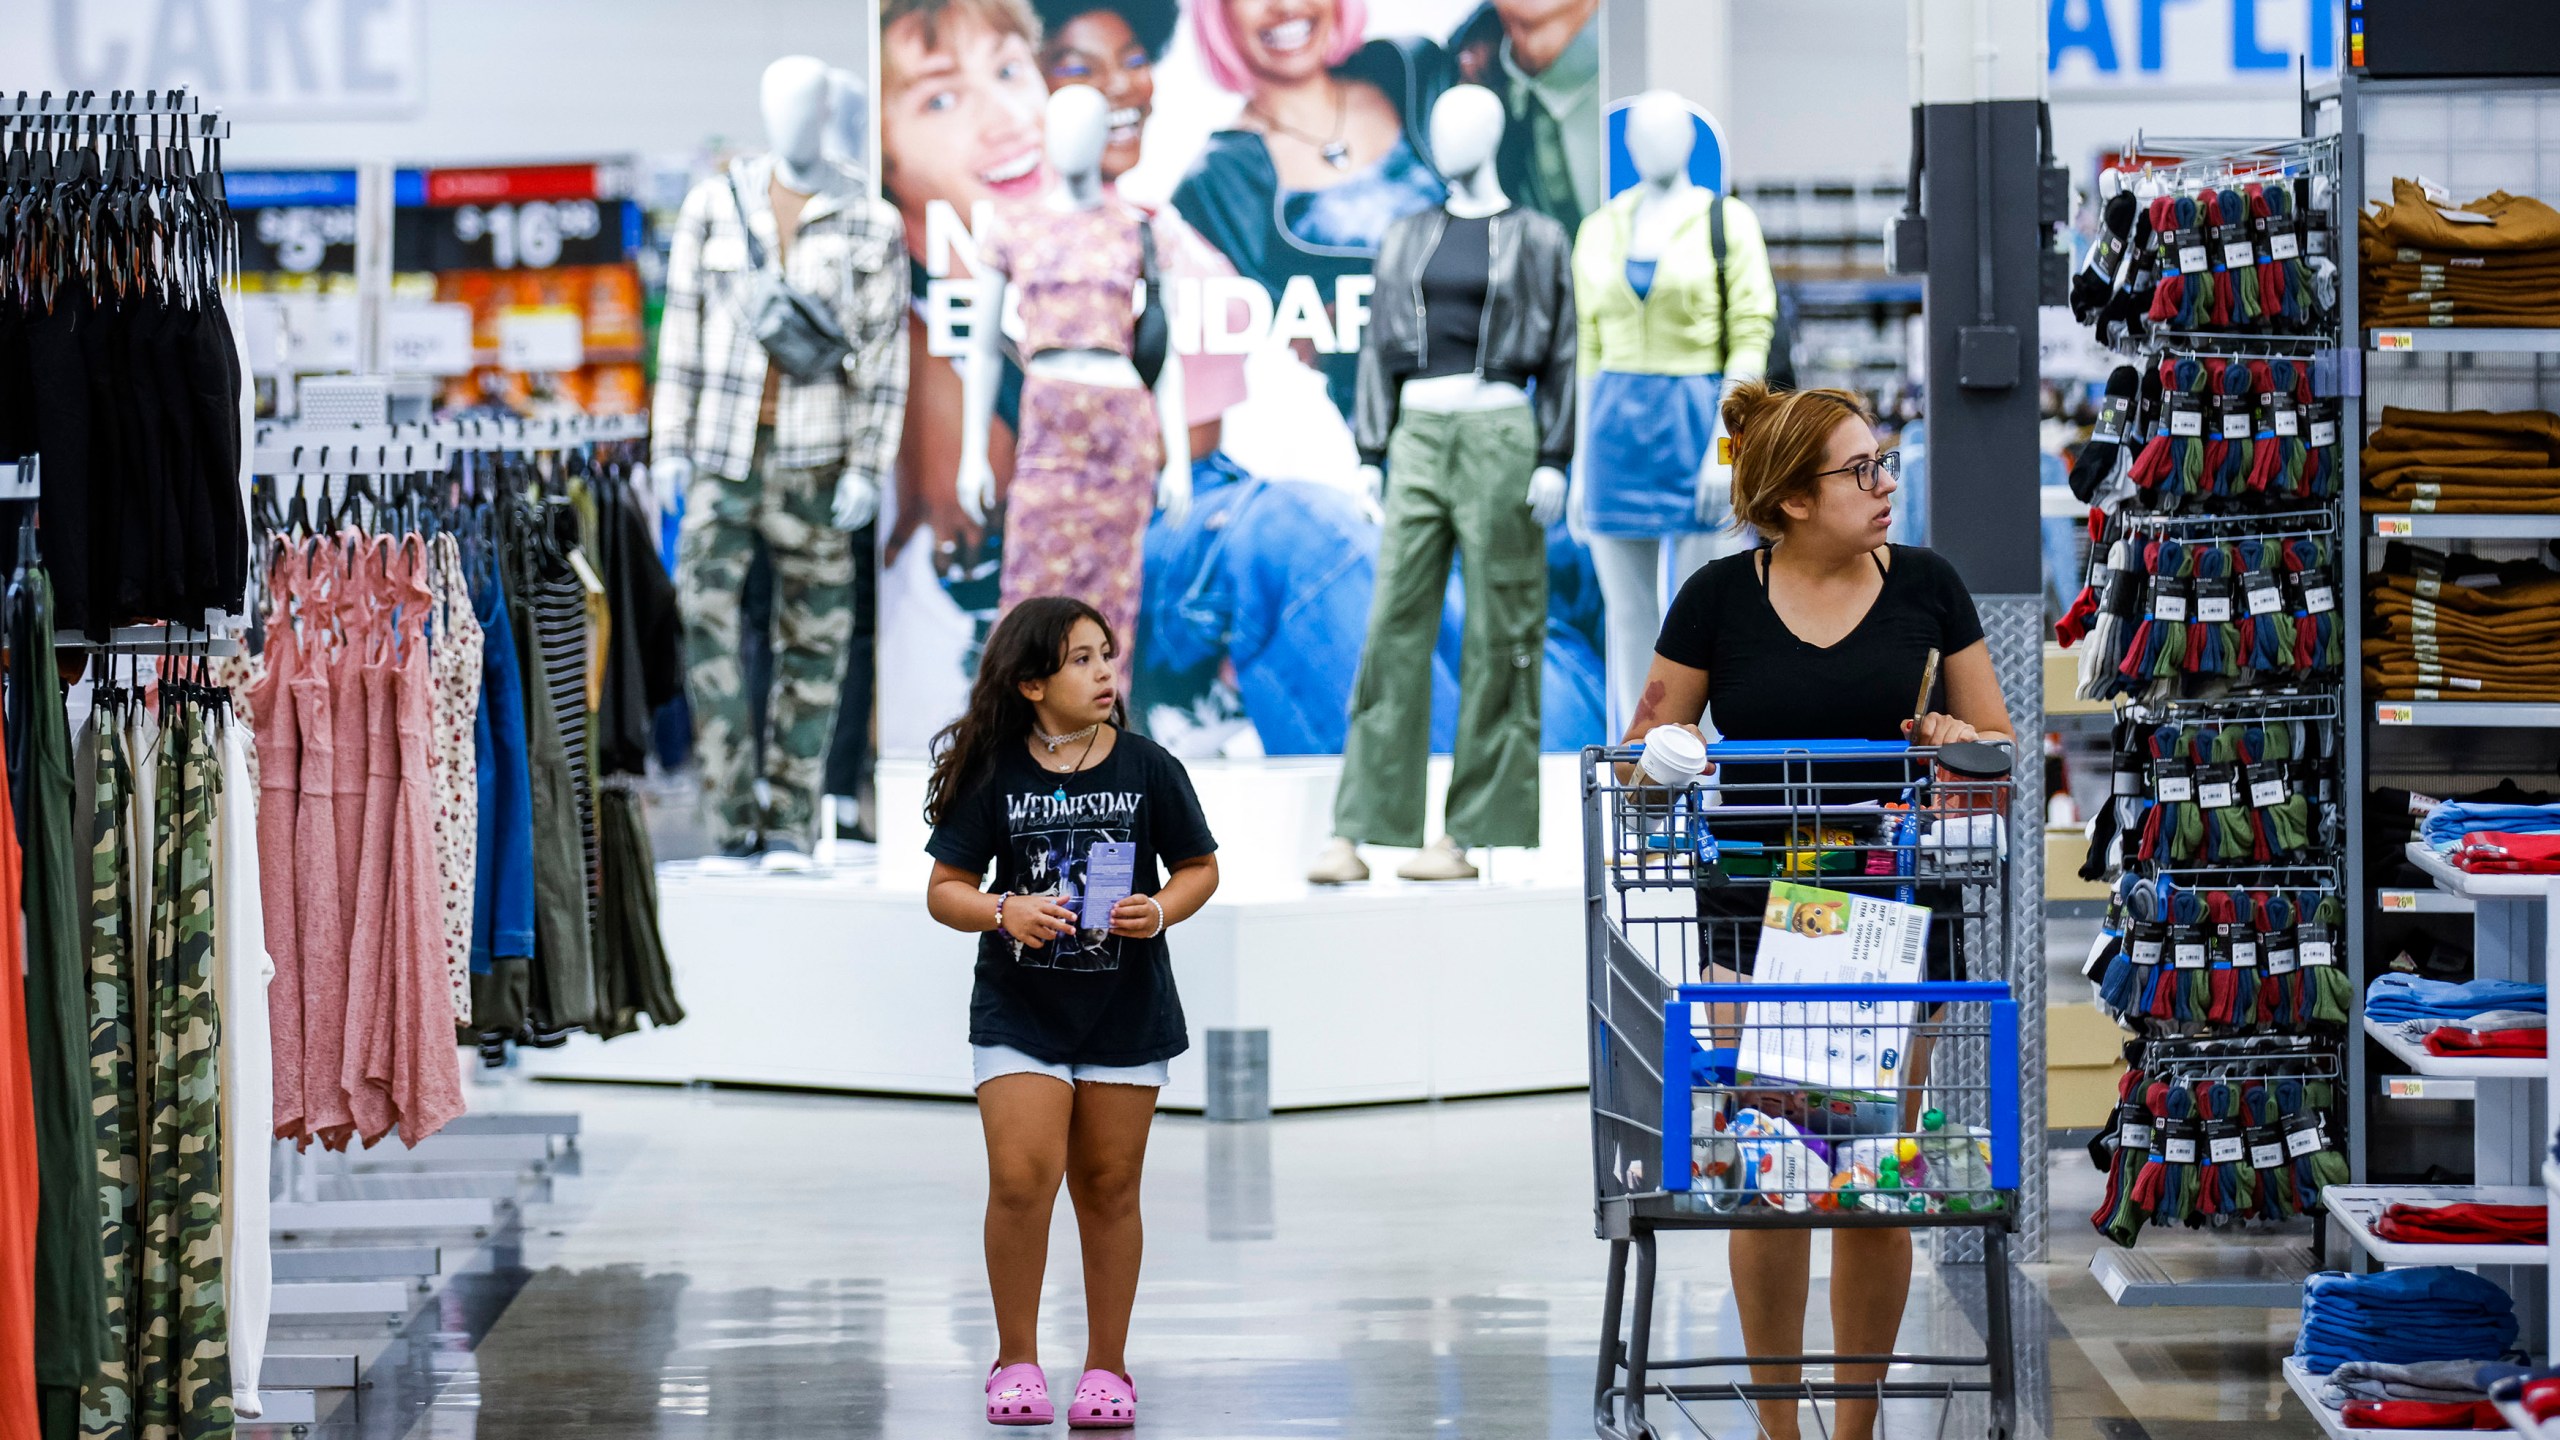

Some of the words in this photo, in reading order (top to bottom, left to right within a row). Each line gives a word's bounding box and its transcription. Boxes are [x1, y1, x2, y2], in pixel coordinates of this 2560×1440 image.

[1006, 792, 1143, 830] WEDNESDAY
[1859, 902, 1868, 918] ITEM
[1870, 903, 1877, 914] PO
[1888, 917, 1896, 926] US
[1784, 1156, 1796, 1200] Cobani
